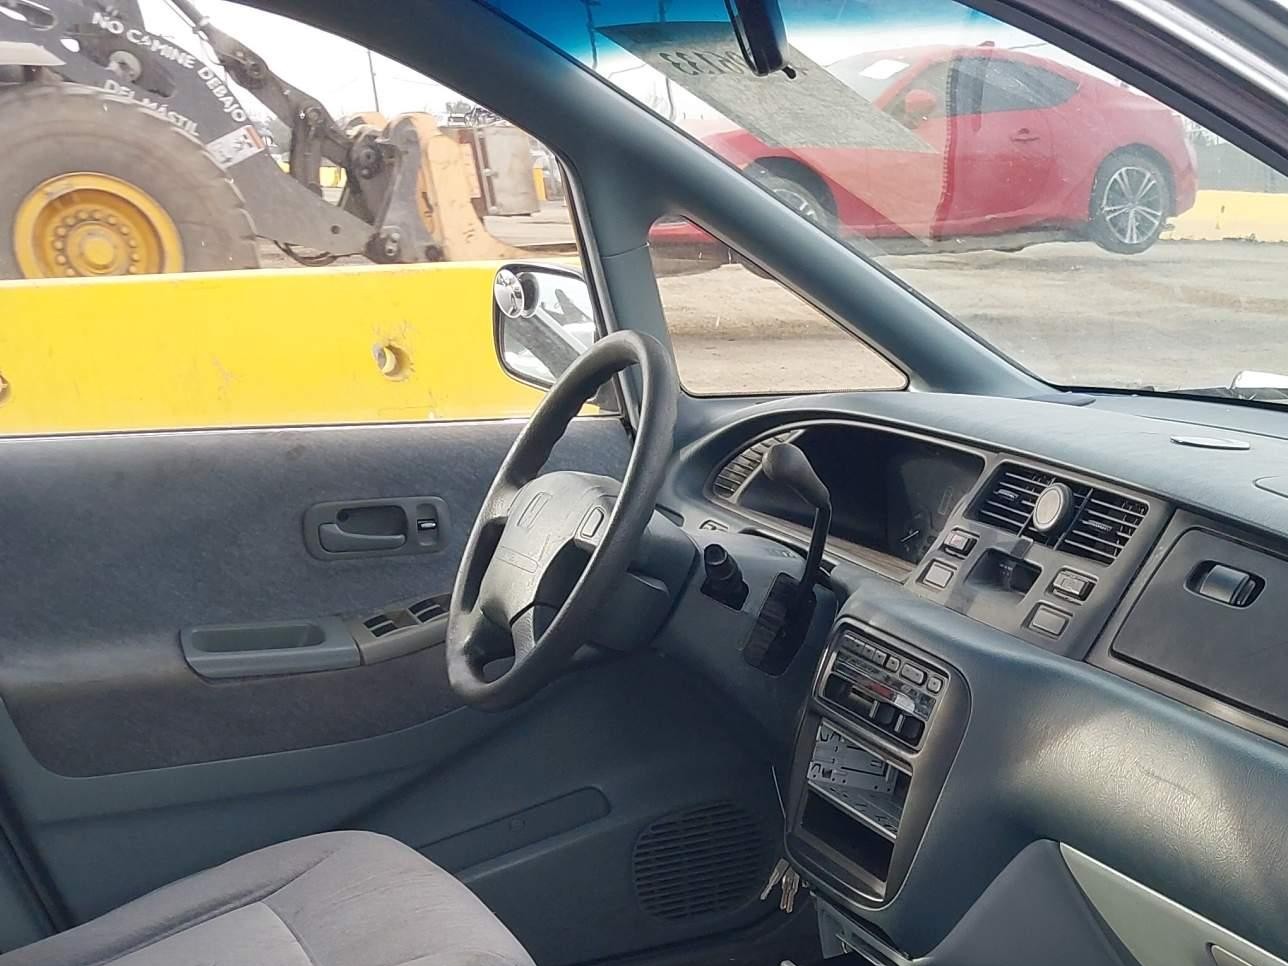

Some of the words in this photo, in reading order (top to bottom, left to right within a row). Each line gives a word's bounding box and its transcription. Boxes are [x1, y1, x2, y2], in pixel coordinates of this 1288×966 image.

[91, 11, 124, 35] NO
[126, 29, 197, 70] CAMINE
[197, 65, 248, 122] DEBAJO
